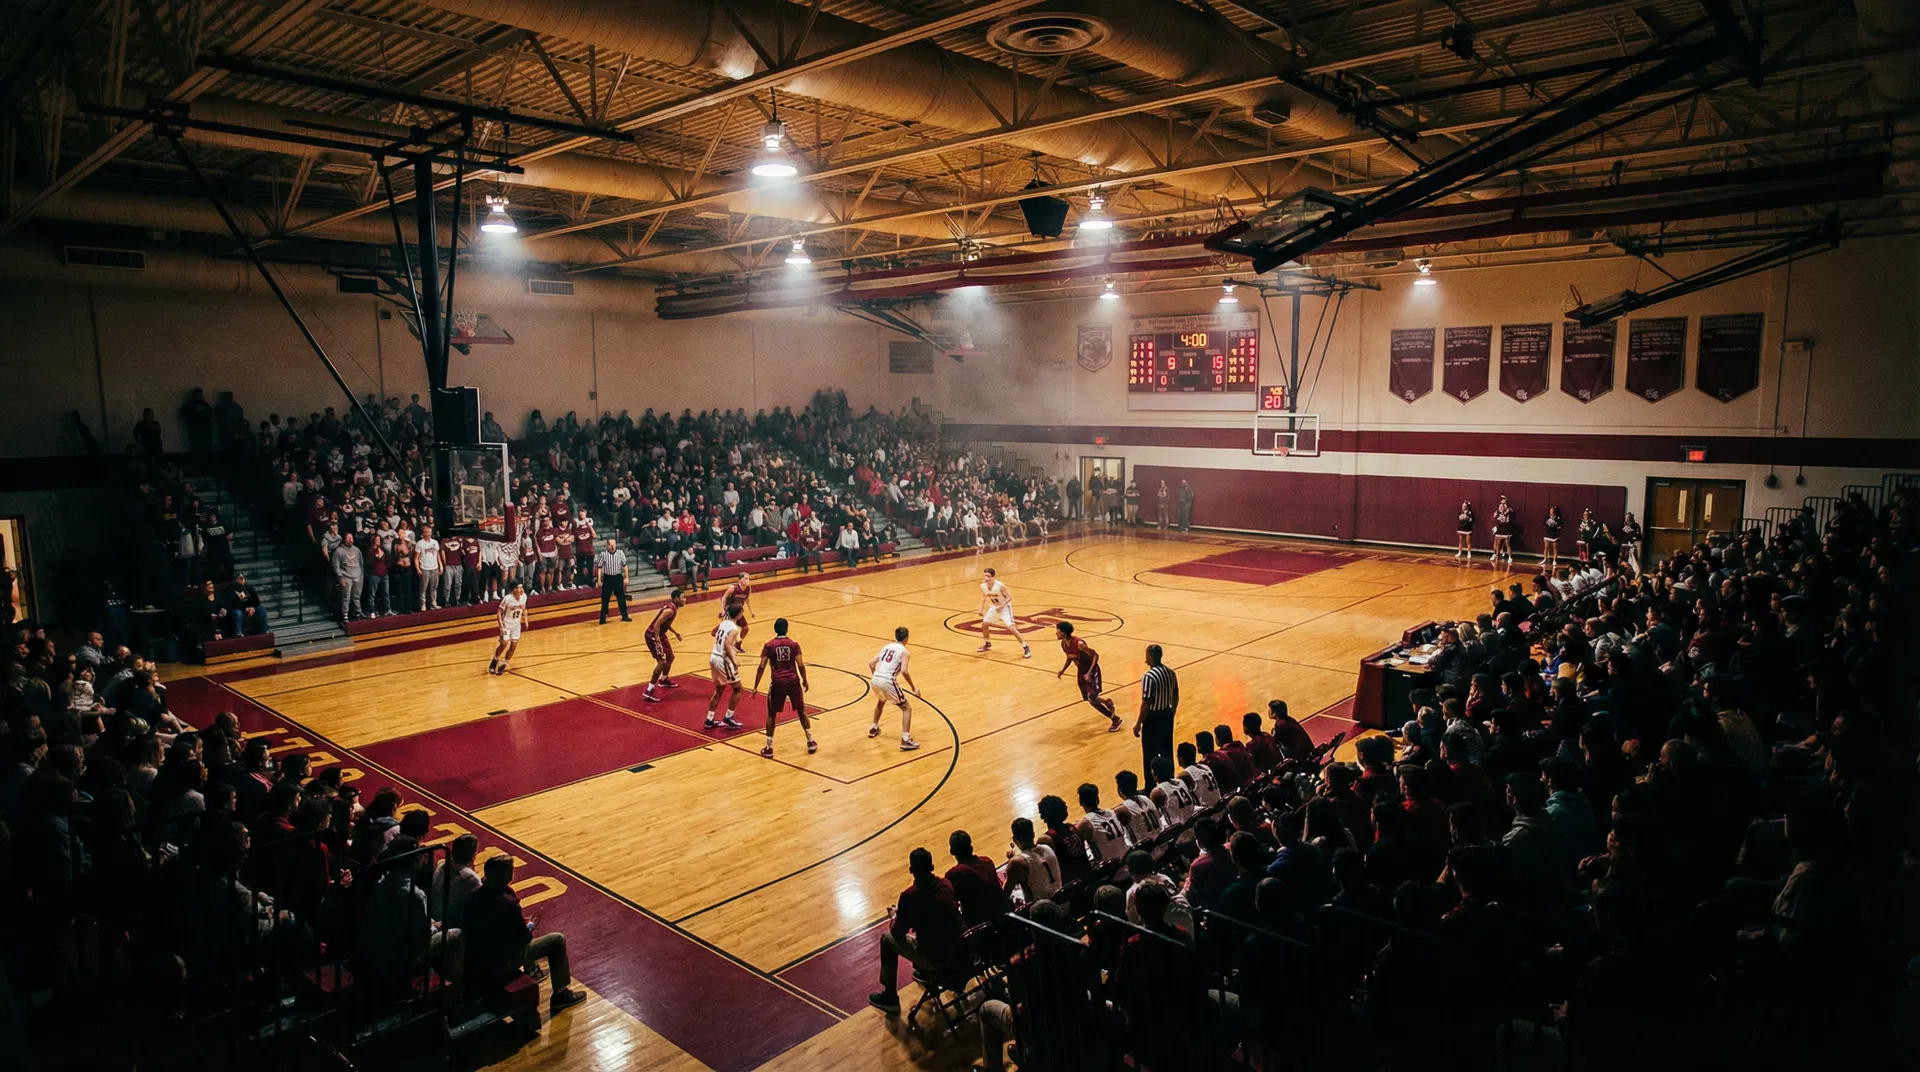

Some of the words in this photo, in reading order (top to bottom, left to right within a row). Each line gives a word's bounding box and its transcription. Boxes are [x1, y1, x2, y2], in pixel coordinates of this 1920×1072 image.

[1181, 333, 1207, 347] 4:00
[1189, 358, 1193, 368] 1
[1212, 355, 1223, 369] 15
[1160, 375, 1167, 385] 0
[1215, 374, 1222, 385] 0
[1264, 395, 1281, 409] 20
